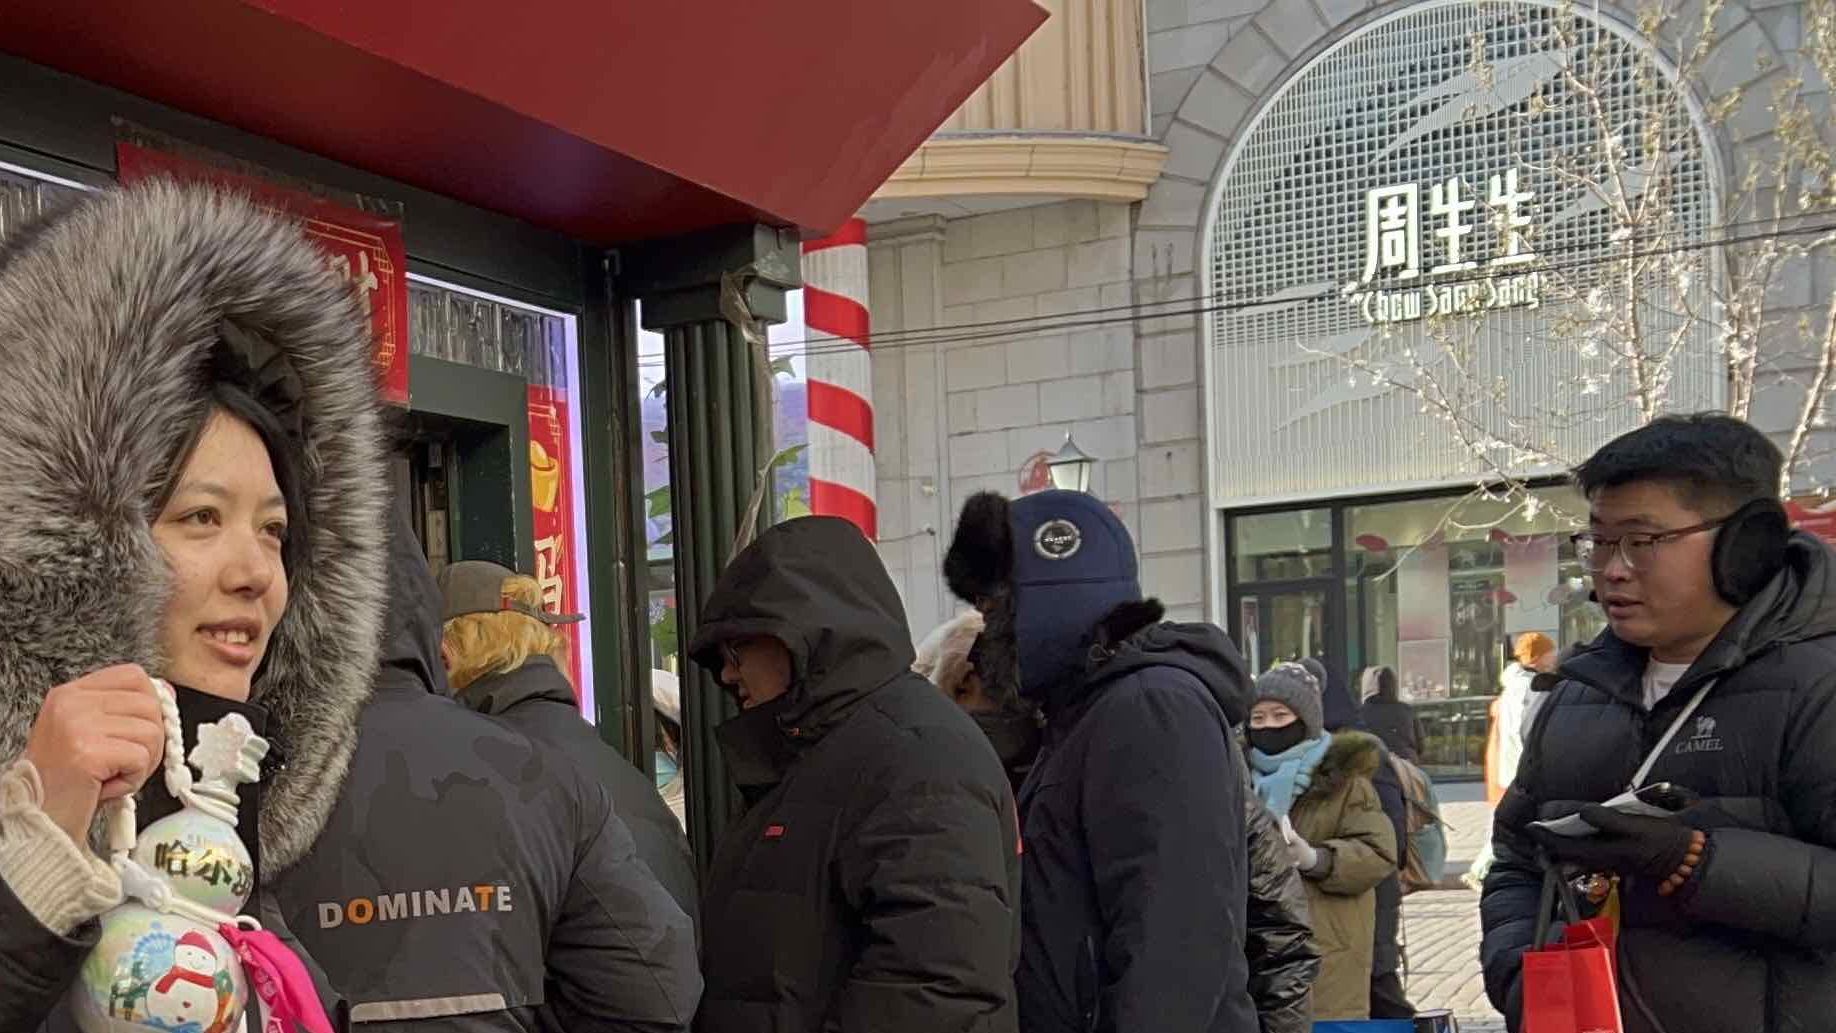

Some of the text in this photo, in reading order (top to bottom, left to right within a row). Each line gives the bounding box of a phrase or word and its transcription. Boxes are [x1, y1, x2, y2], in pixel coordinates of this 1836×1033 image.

[1362, 168, 1535, 284] 周生生
[1675, 738, 1724, 754] CAMEL
[318, 885, 513, 929] DOMINATE
